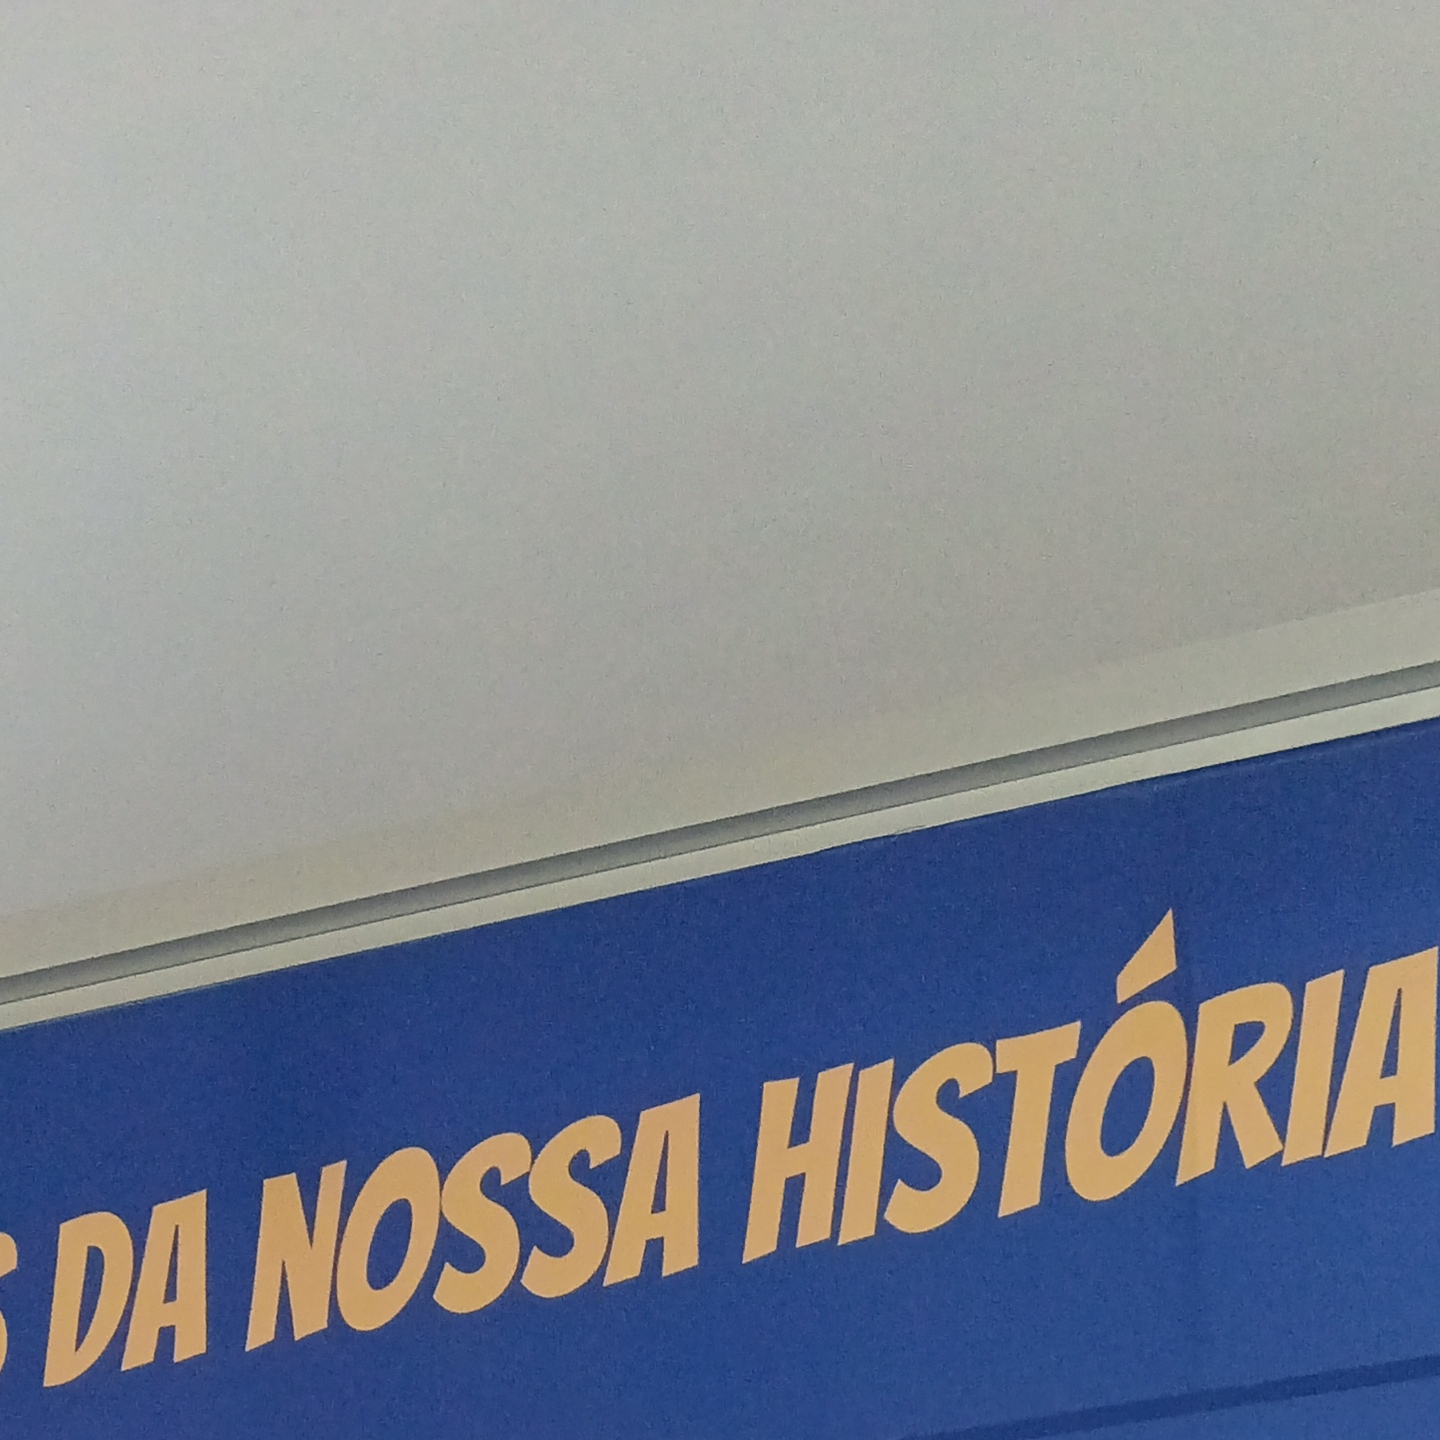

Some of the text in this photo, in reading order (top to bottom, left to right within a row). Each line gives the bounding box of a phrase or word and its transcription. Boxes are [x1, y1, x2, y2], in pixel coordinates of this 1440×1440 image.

[43, 1189, 206, 1387] DA
[245, 1093, 700, 1351] NOSSA
[742, 909, 1438, 1263] HISTÓRIA
